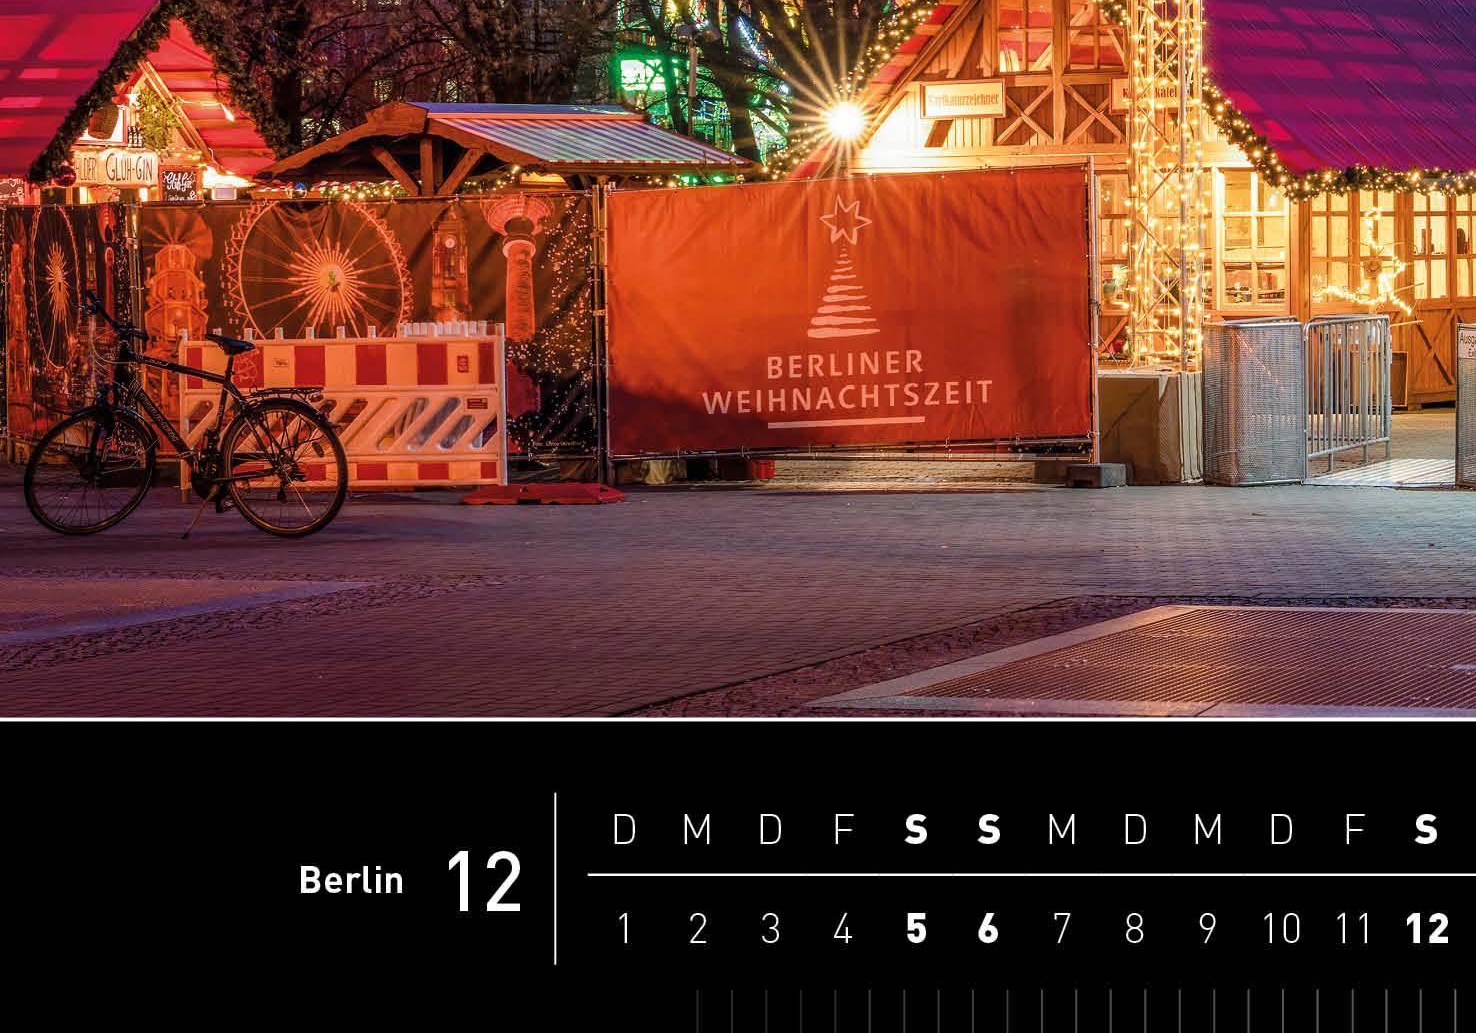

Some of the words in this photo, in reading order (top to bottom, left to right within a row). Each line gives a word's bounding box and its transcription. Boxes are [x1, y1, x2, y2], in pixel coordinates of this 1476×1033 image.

[767, 349, 924, 380] BERLINER
[1468, 348, 1476, 357] Exit
[701, 380, 993, 415] WEIHNACHTSZEIT
